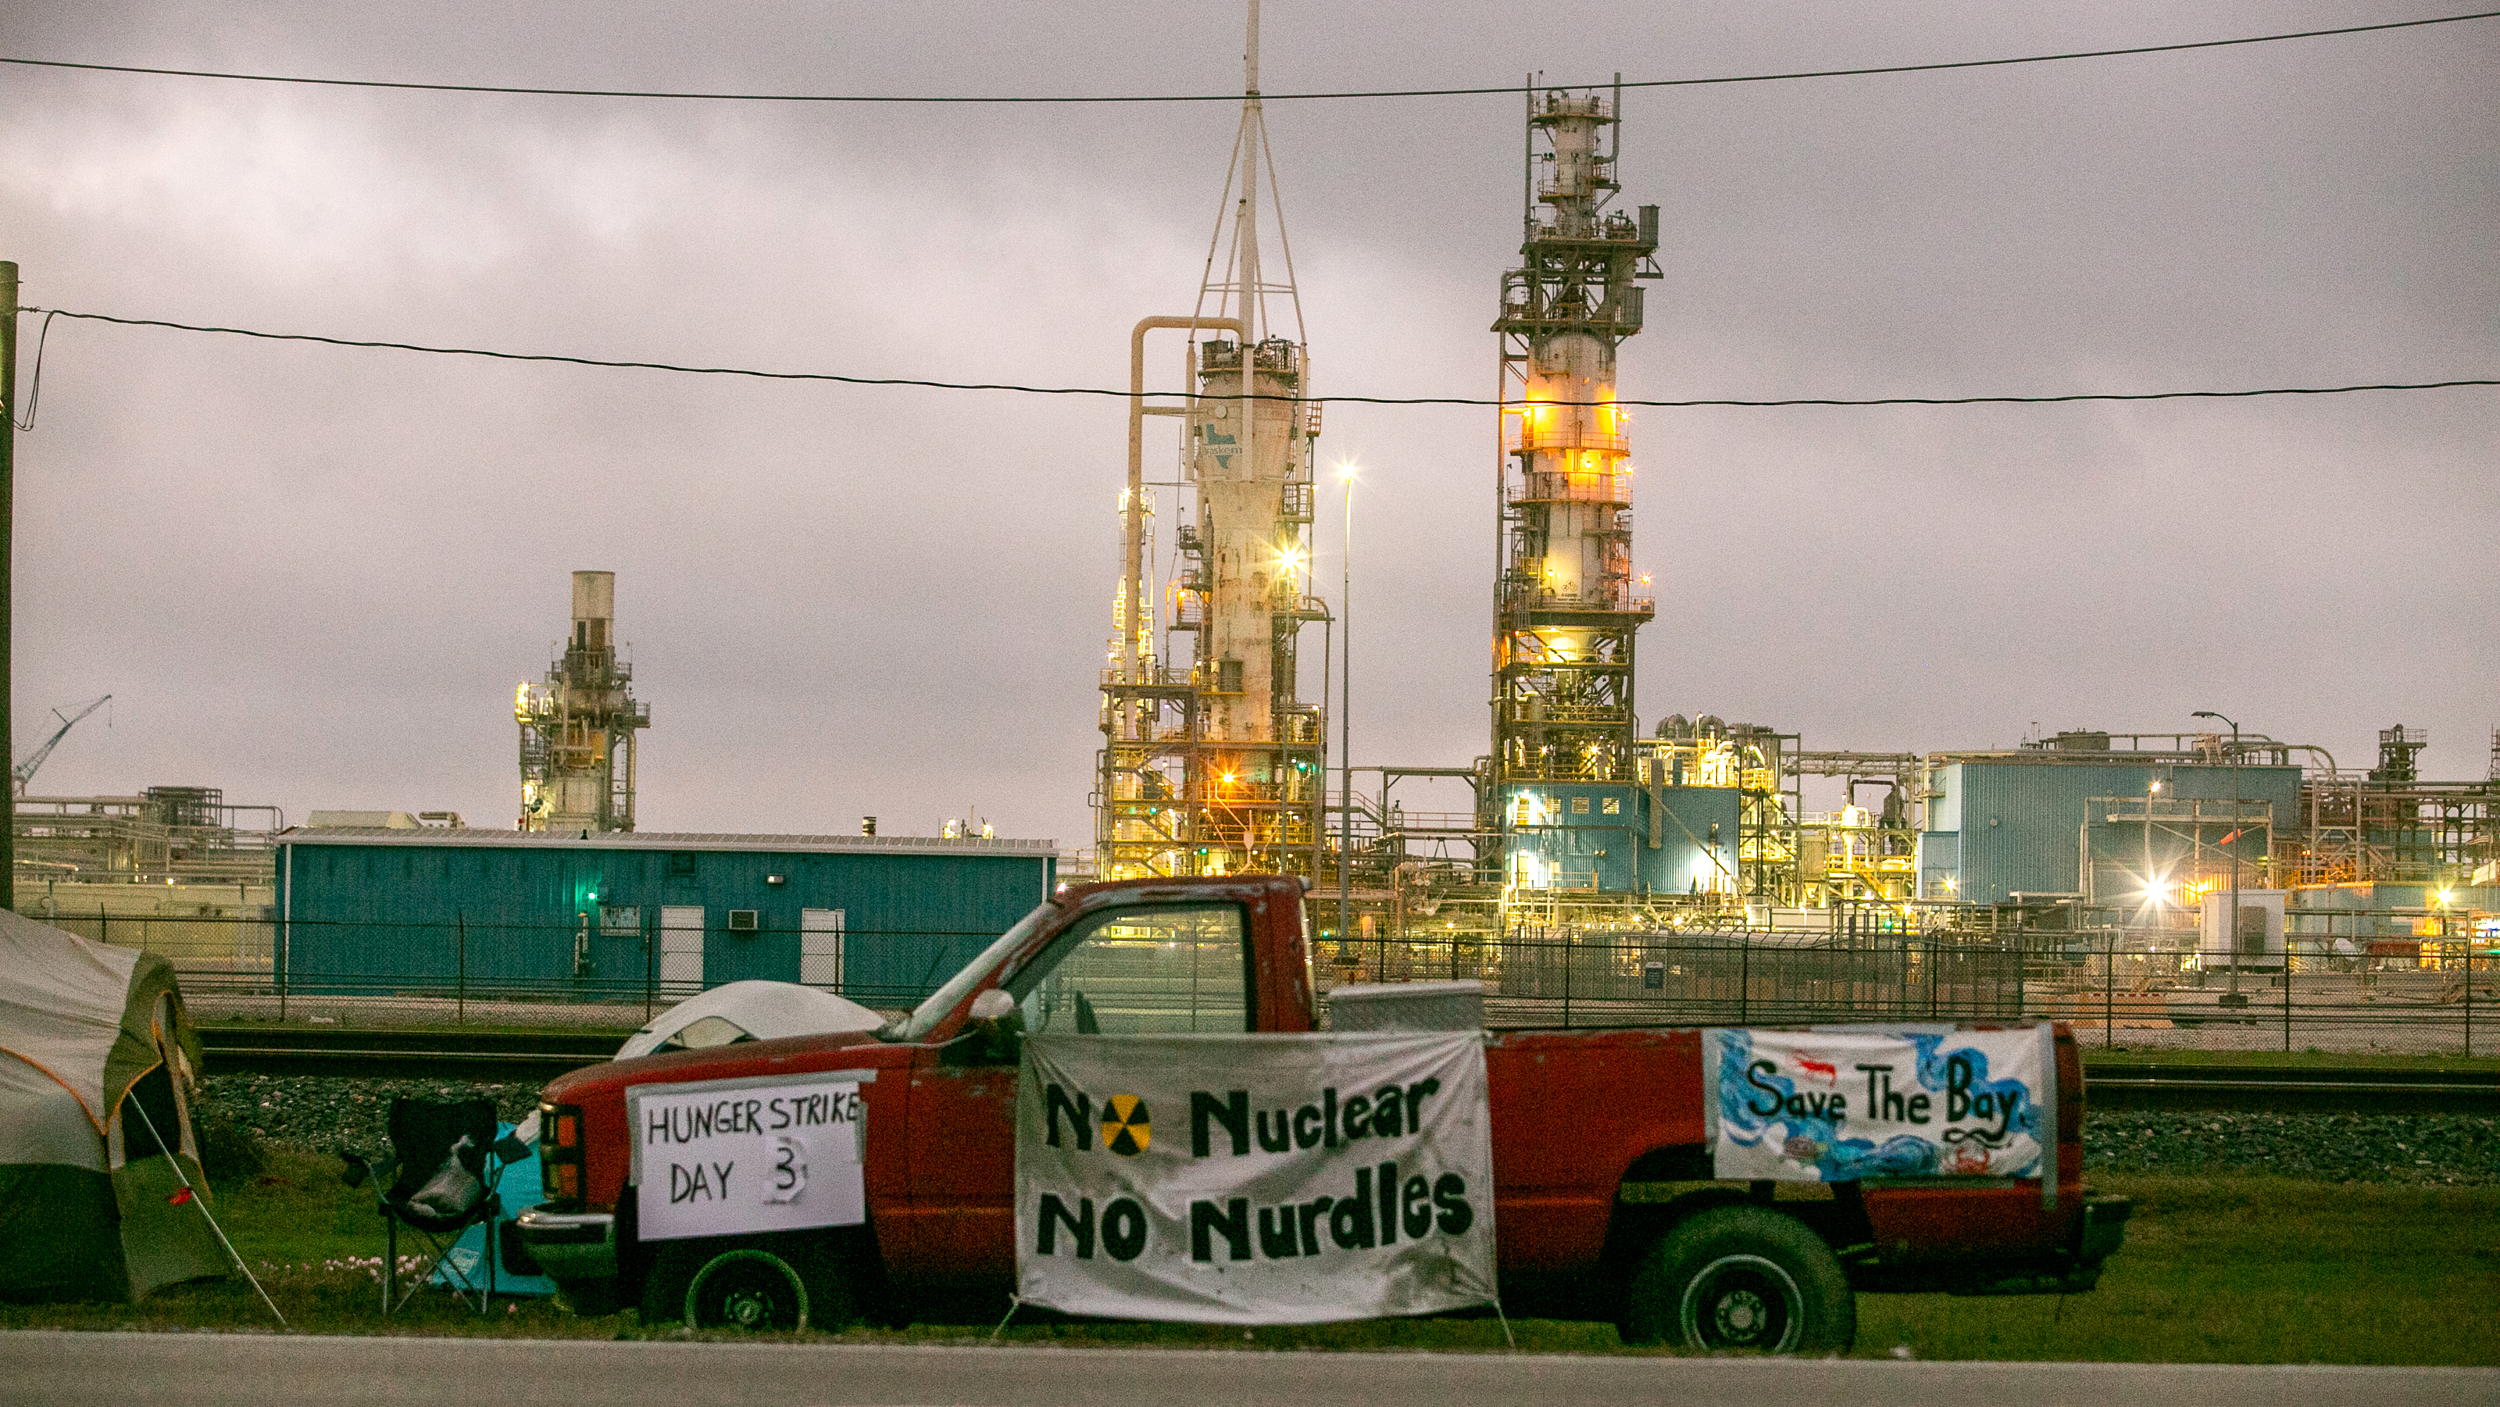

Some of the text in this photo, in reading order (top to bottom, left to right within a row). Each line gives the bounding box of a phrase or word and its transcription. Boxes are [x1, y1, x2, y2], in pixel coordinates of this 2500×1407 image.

[648, 1091, 860, 1145] HUNGER STRIKE
[1190, 1076, 1441, 1157] Nuclear
[1747, 1055, 2019, 1149] Save The Bay
[671, 1146, 797, 1203] DAY 3
[1190, 1160, 1475, 1263] Nurdles
